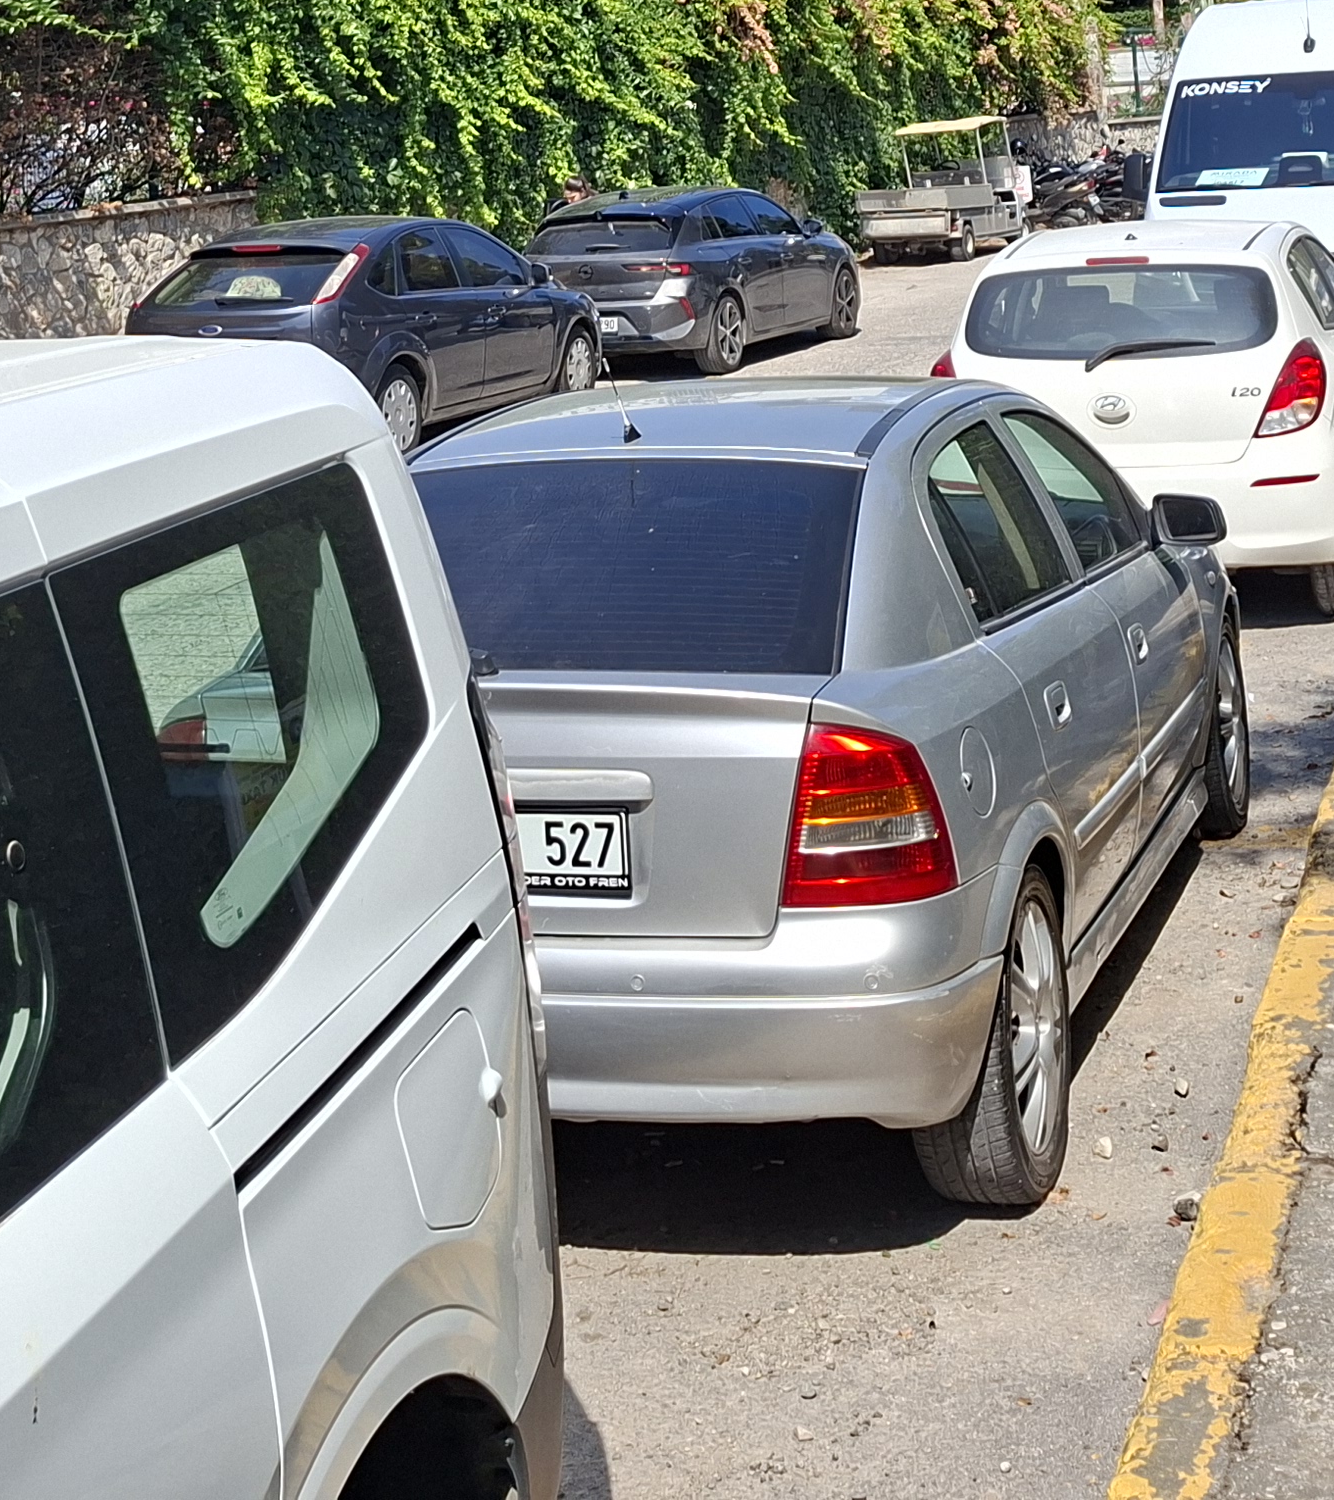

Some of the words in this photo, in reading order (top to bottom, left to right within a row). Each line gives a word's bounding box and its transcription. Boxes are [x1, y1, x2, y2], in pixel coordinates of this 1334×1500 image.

[1181, 77, 1271, 98] KONSEY
[545, 821, 614, 868] 527
[554, 876, 586, 887] OTO
[589, 877, 628, 888] FREN
